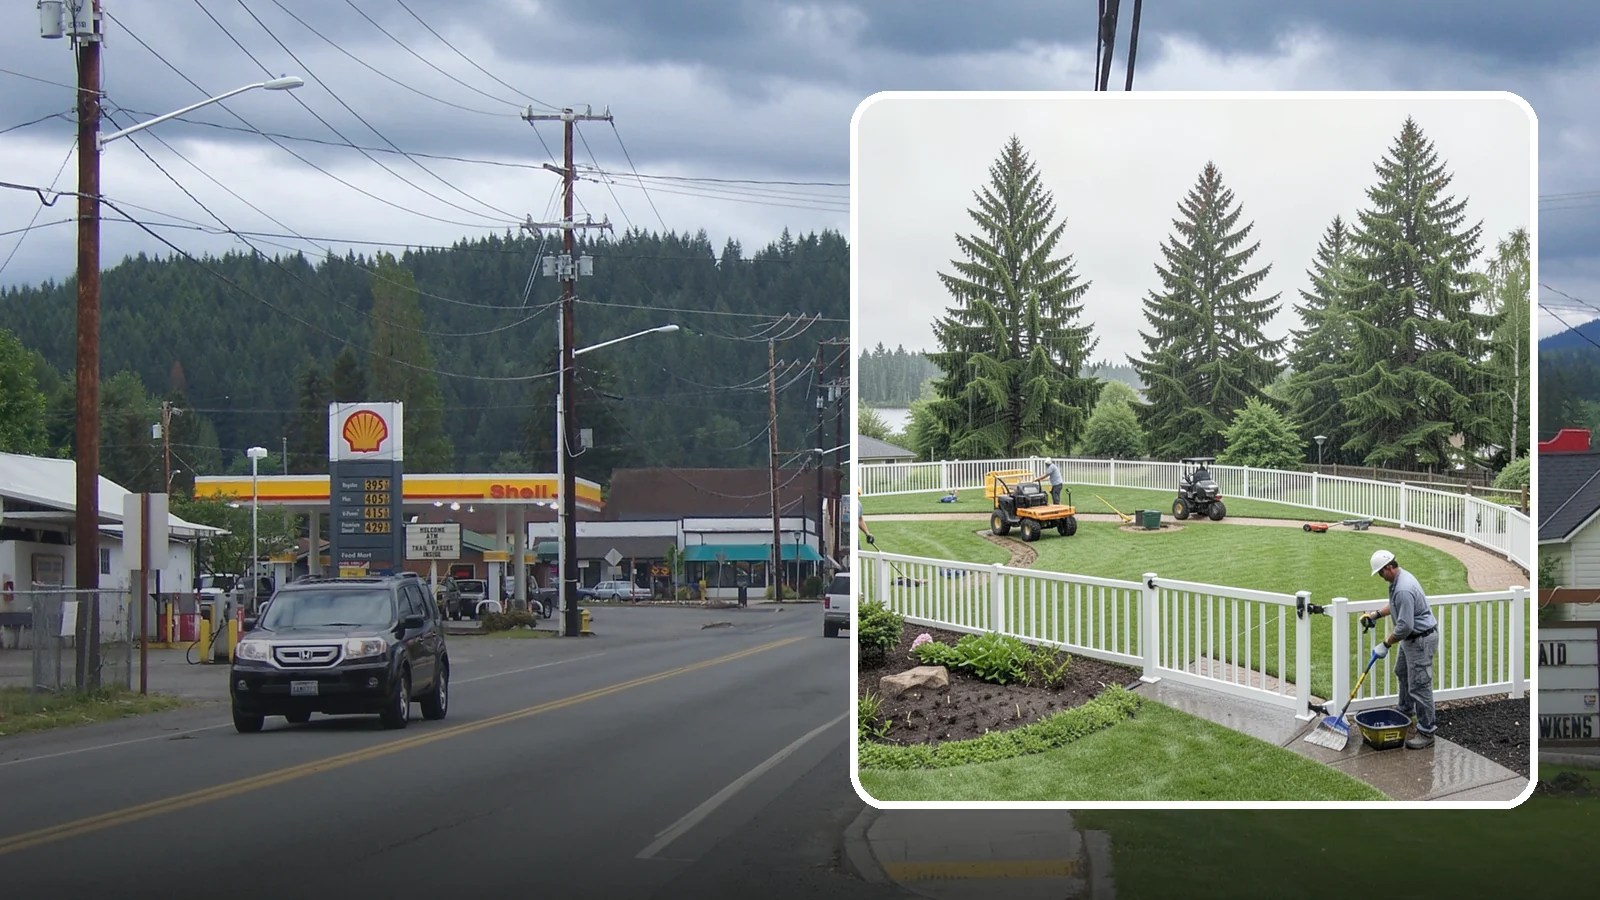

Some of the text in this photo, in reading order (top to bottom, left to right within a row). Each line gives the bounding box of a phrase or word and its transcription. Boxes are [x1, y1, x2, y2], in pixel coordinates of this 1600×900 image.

[366, 480, 383, 490] 395
[490, 484, 547, 499] Shell
[366, 494, 383, 504] 405
[366, 508, 383, 518] 415
[366, 522, 383, 533] 429
